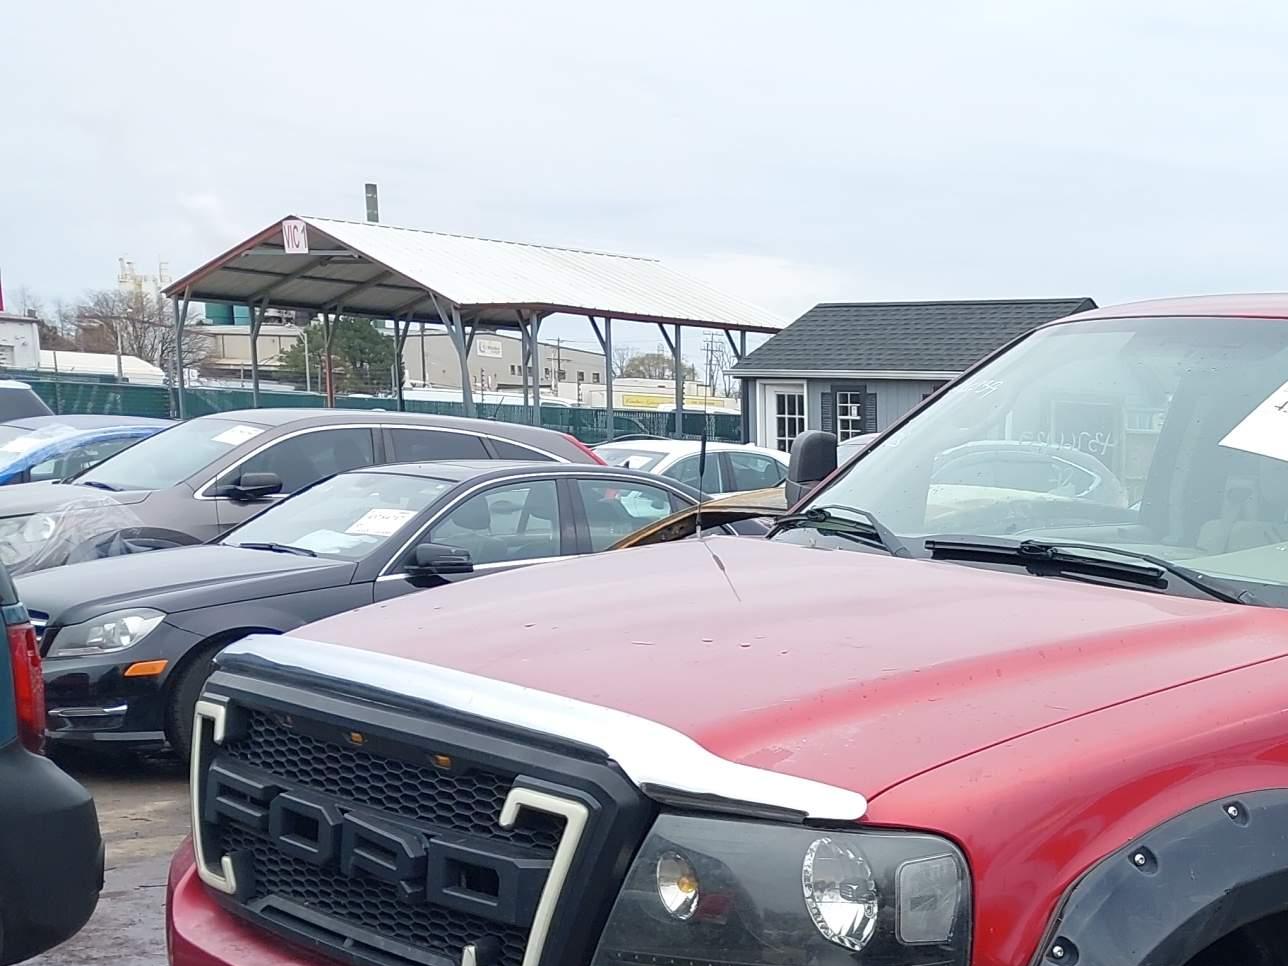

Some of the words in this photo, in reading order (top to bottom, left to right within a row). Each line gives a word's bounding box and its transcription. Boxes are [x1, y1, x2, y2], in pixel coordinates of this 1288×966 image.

[283, 225, 300, 248] VIC
[300, 225, 307, 248] 1
[206, 760, 554, 928] FORD
